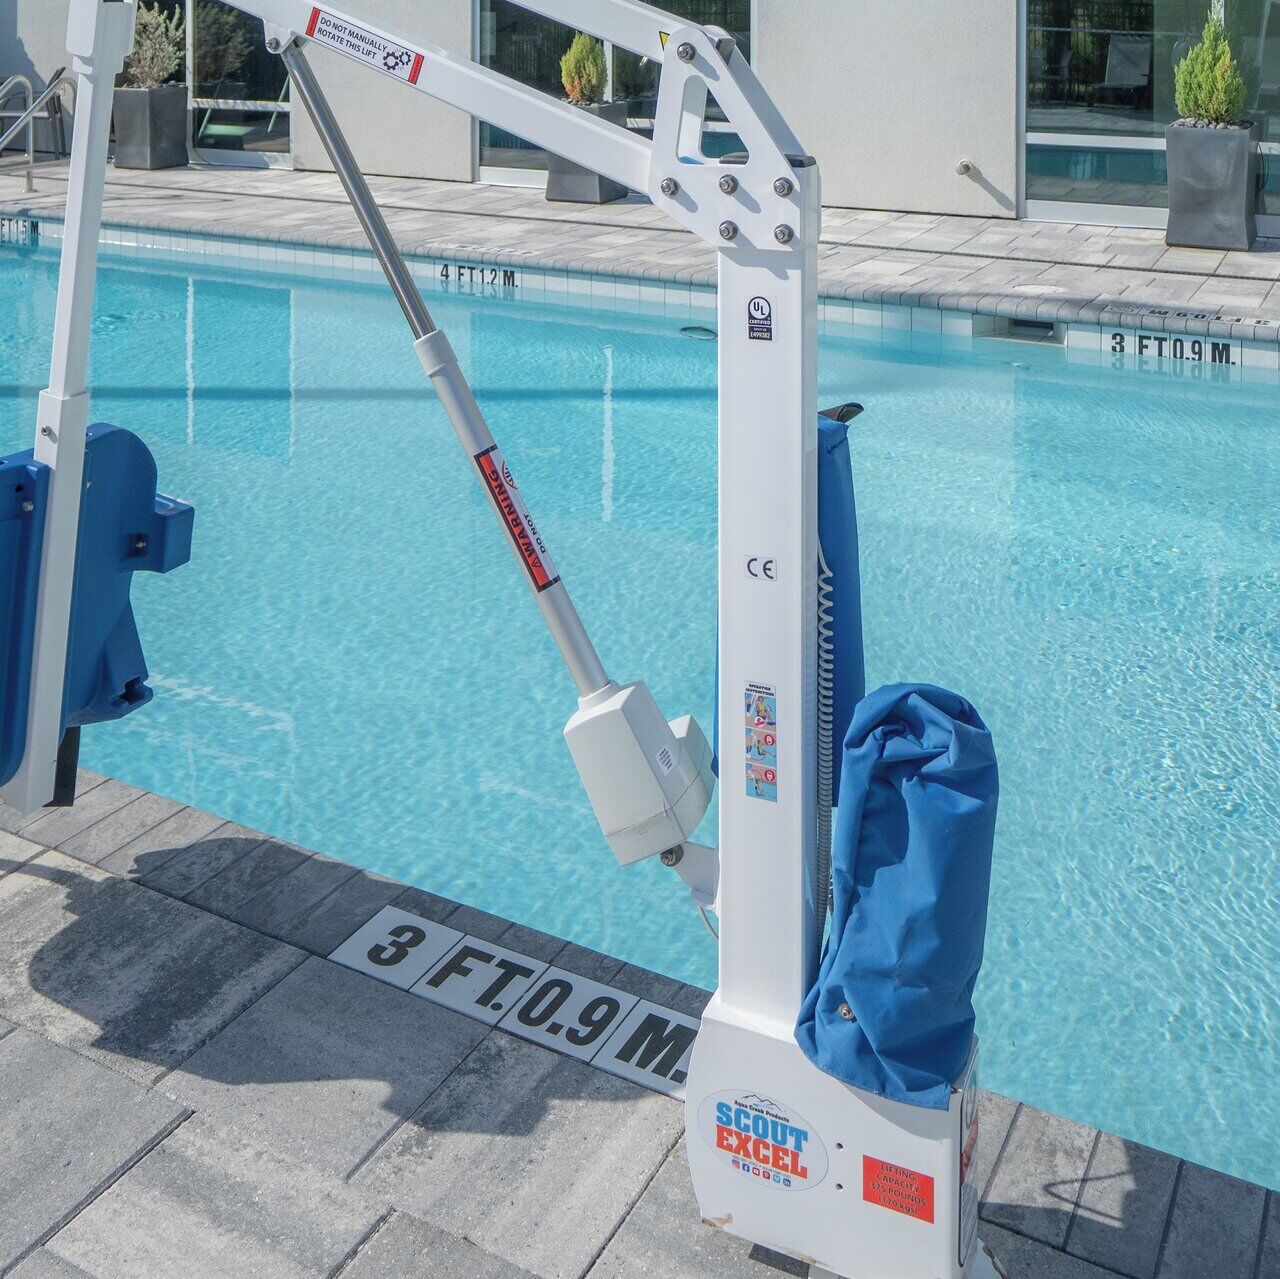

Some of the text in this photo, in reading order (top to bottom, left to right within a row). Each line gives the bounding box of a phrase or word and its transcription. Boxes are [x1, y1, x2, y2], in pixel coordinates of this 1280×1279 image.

[317, 27, 377, 60] ROTATE THIS LIFT
[320, 17, 332, 27] DO
[332, 22, 348, 33] NOT
[348, 29, 388, 53] MANUALLY
[440, 263, 450, 280] 4
[479, 267, 497, 285] 1.2
[753, 302, 766, 316] UL
[1111, 332, 1125, 353] 3
[1172, 338, 1202, 361] 0.9
[1211, 341, 1236, 365] M.
[488, 470, 537, 558] WARNING
[524, 513, 546, 554] DO NOT
[747, 557, 774, 580] CE
[366, 924, 427, 967] 3
[425, 944, 536, 1012] FT.
[516, 978, 621, 1047] 0.9
[716, 1101, 808, 1153] SCOUT
[734, 1100, 748, 1109] Aqua
[765, 1110, 789, 1123] Products
[716, 1123, 808, 1180] EXCEL
[876, 1172, 920, 1193] CAPACITY
[881, 1164, 915, 1181] LIFTING
[871, 1182, 926, 1207] 375 POUNDS
